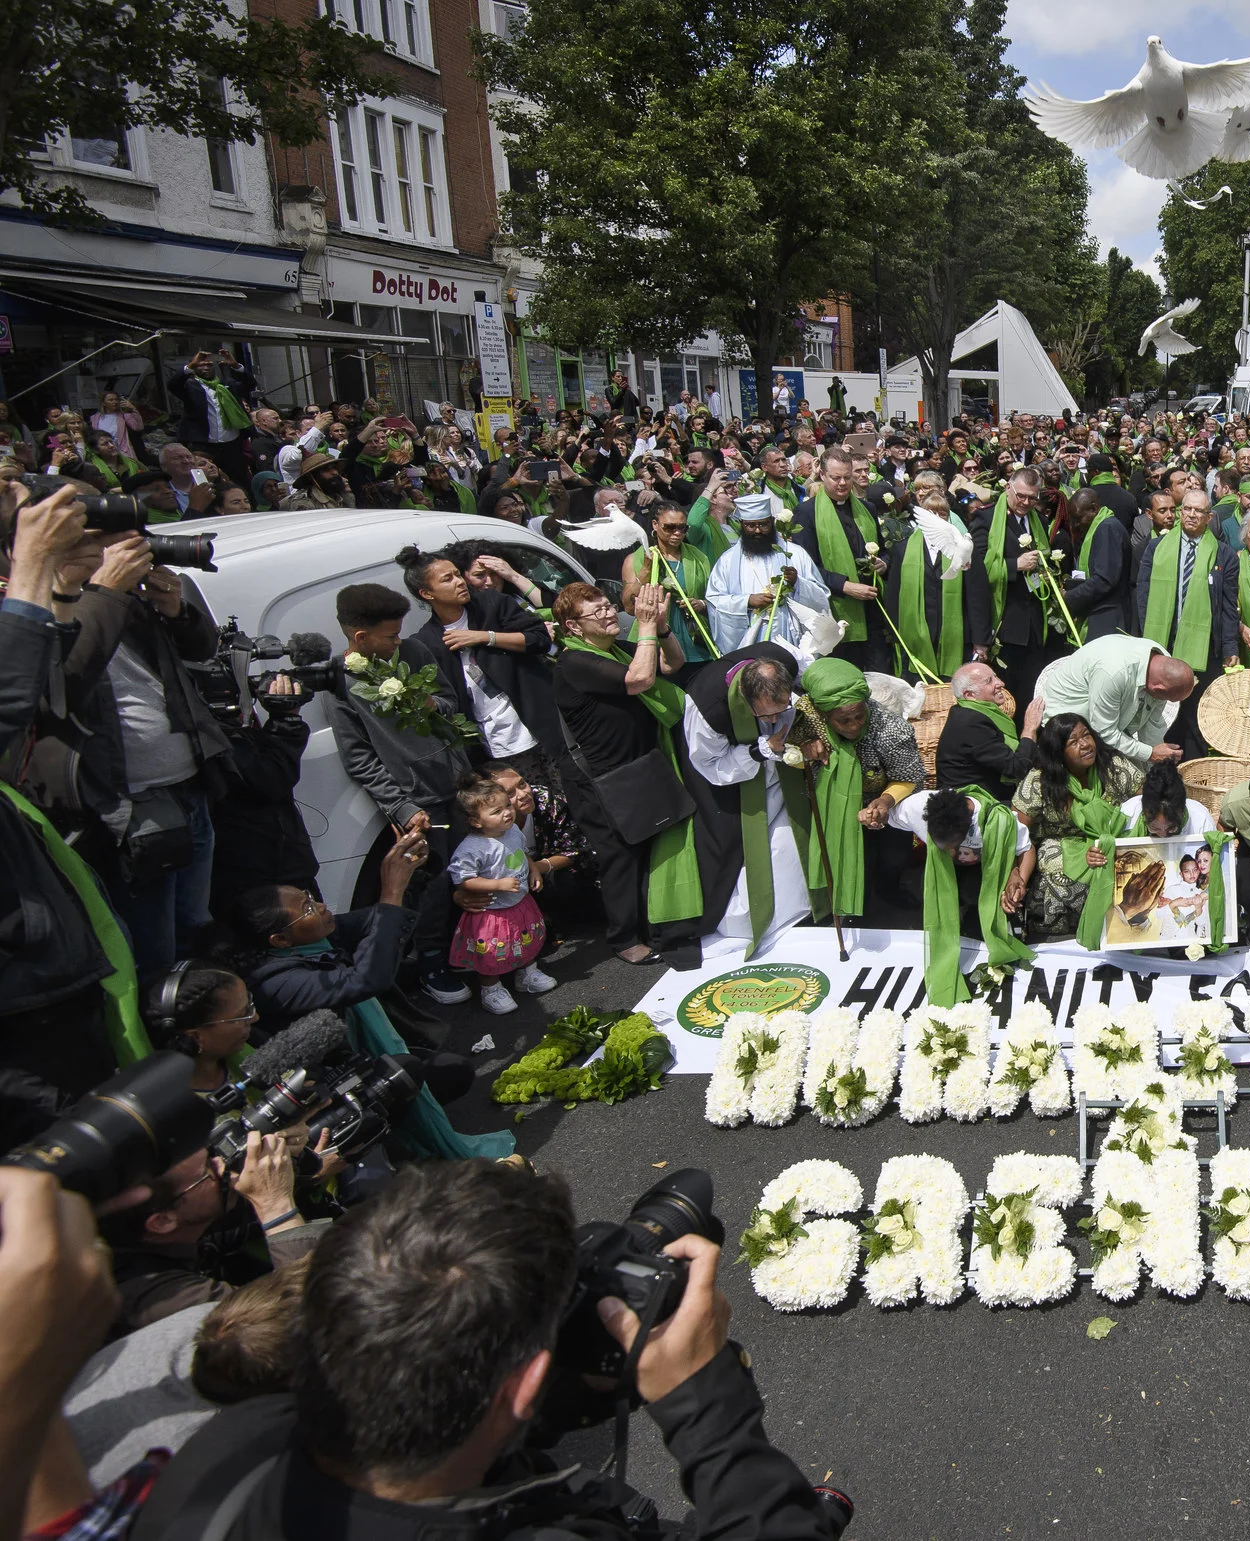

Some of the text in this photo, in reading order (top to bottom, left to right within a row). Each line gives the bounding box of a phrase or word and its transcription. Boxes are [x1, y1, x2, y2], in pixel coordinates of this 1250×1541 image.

[284, 269, 298, 284] 65
[372, 269, 458, 304] Dotty Dot
[722, 986, 802, 995] GRENFELL
[839, 964, 1160, 1029] HUANITY
